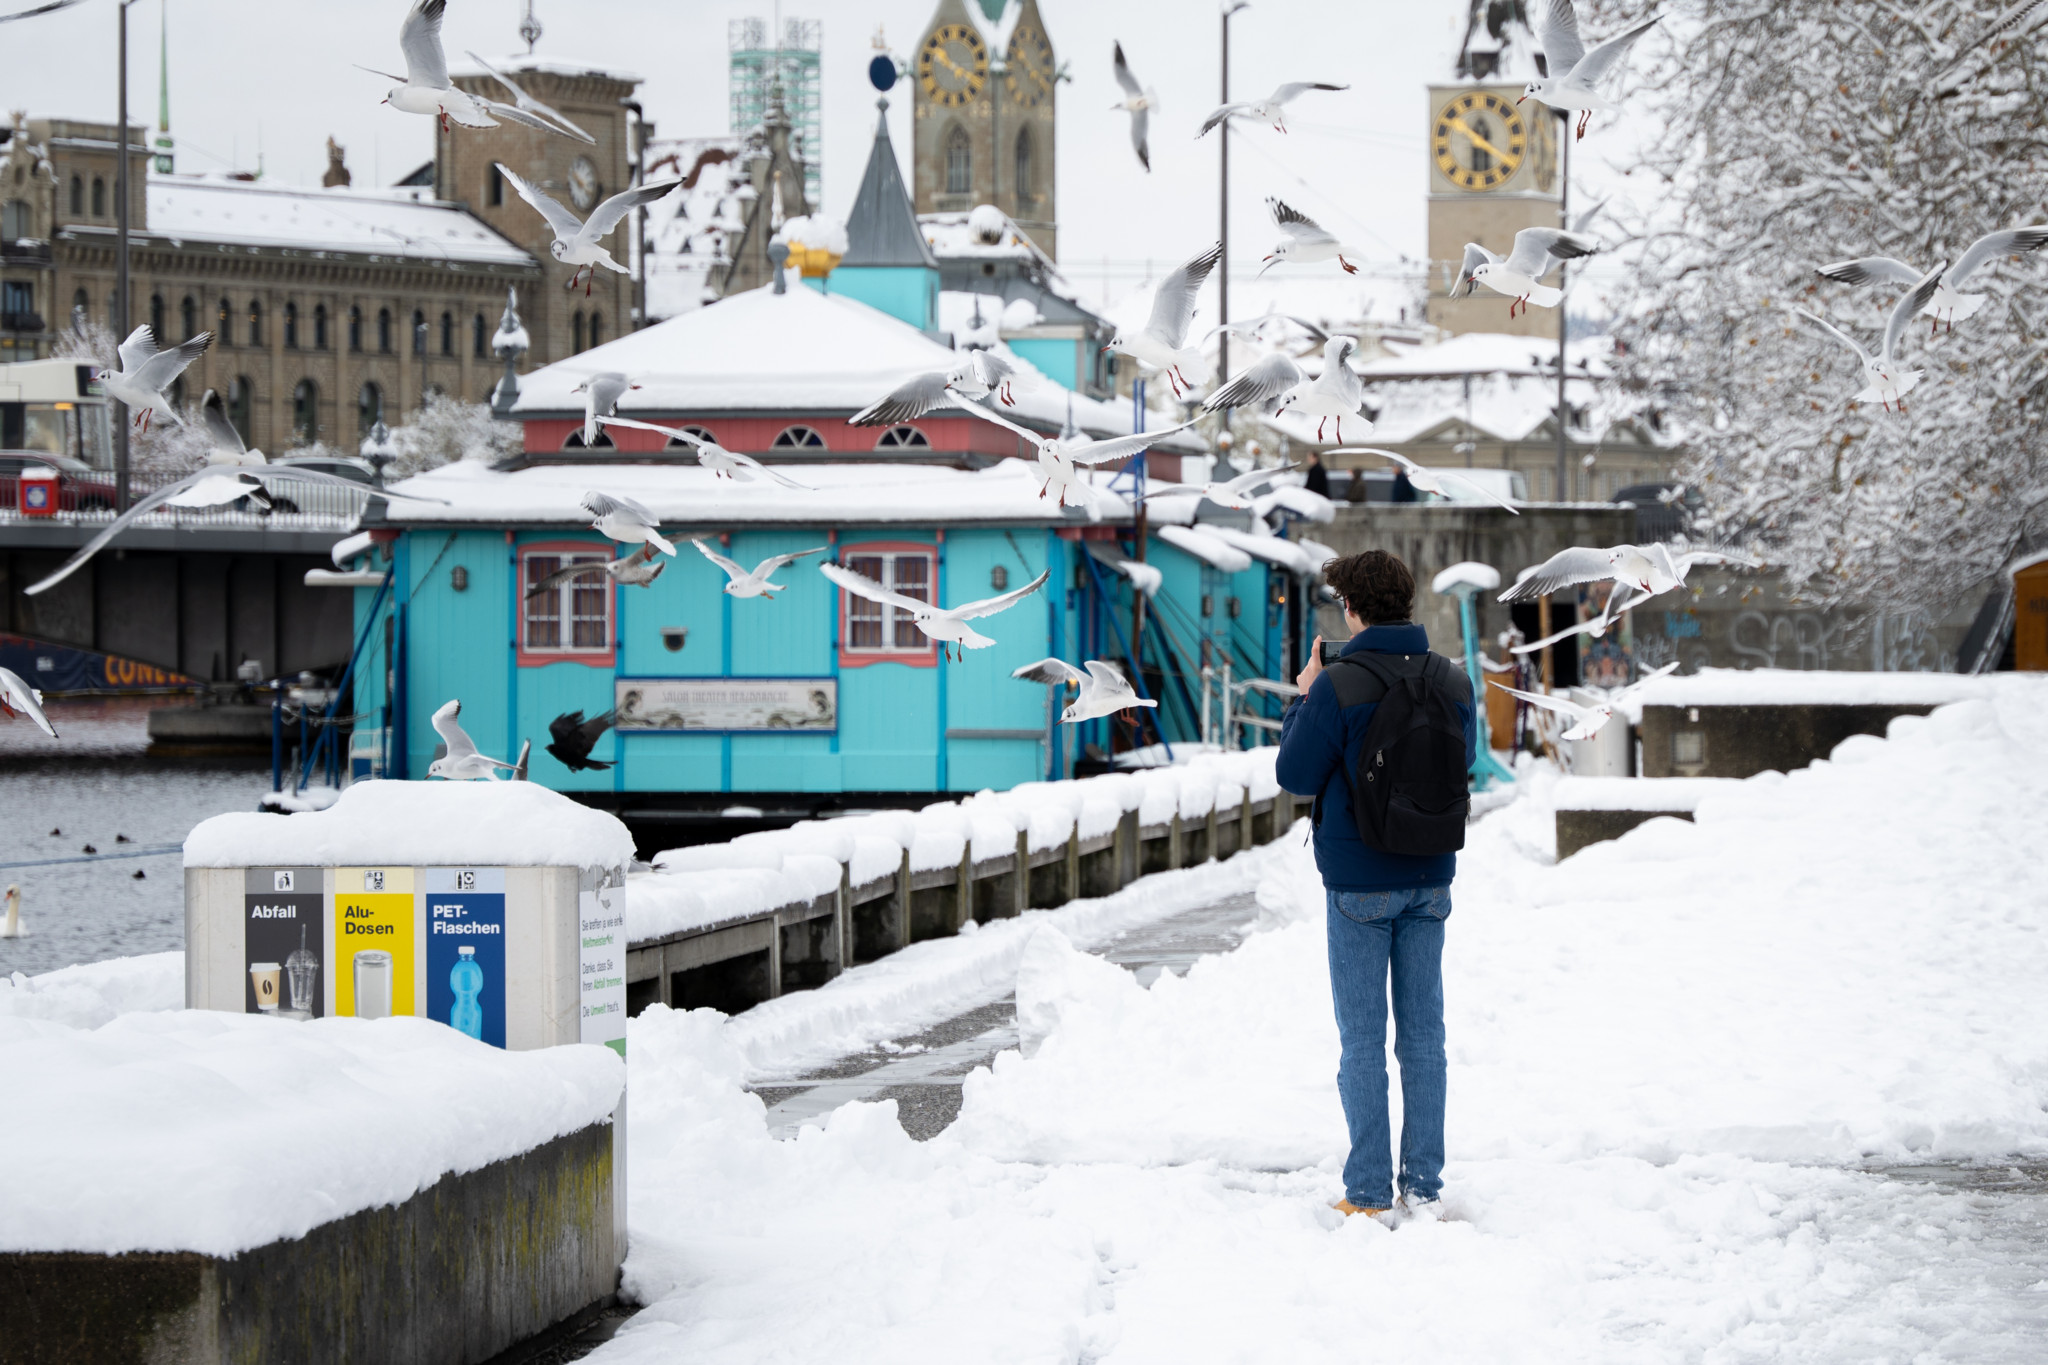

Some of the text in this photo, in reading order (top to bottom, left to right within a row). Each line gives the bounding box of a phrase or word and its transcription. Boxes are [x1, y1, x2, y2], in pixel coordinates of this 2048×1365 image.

[251, 904, 297, 919] Abfall
[344, 905, 375, 919] Alu-
[433, 904, 469, 918] PET-
[345, 921, 394, 935] Dosen
[433, 921, 500, 935] Flaschen
